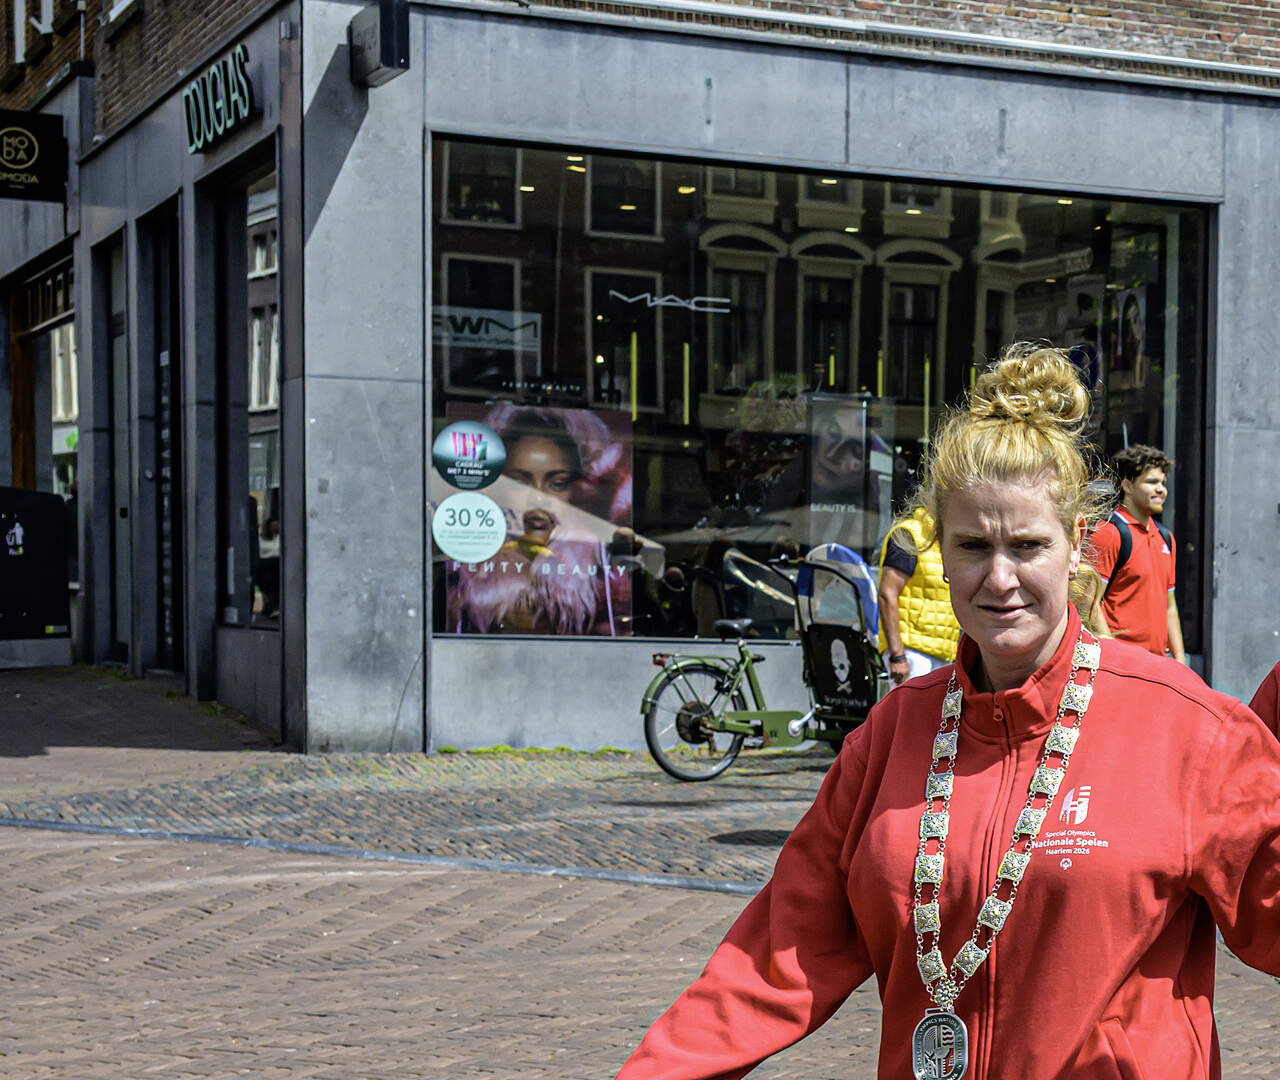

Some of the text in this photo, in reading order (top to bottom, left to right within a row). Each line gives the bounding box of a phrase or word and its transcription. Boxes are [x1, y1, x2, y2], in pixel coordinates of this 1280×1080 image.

[182, 44, 250, 154] DOUGLAS
[3, 135, 29, 149] MO
[609, 289, 731, 313] MAC
[541, 562, 627, 577] BEAUTY
[1032, 837, 1109, 849] Nationale Spelen
[1045, 847, 1090, 855] Haarlem 2026
